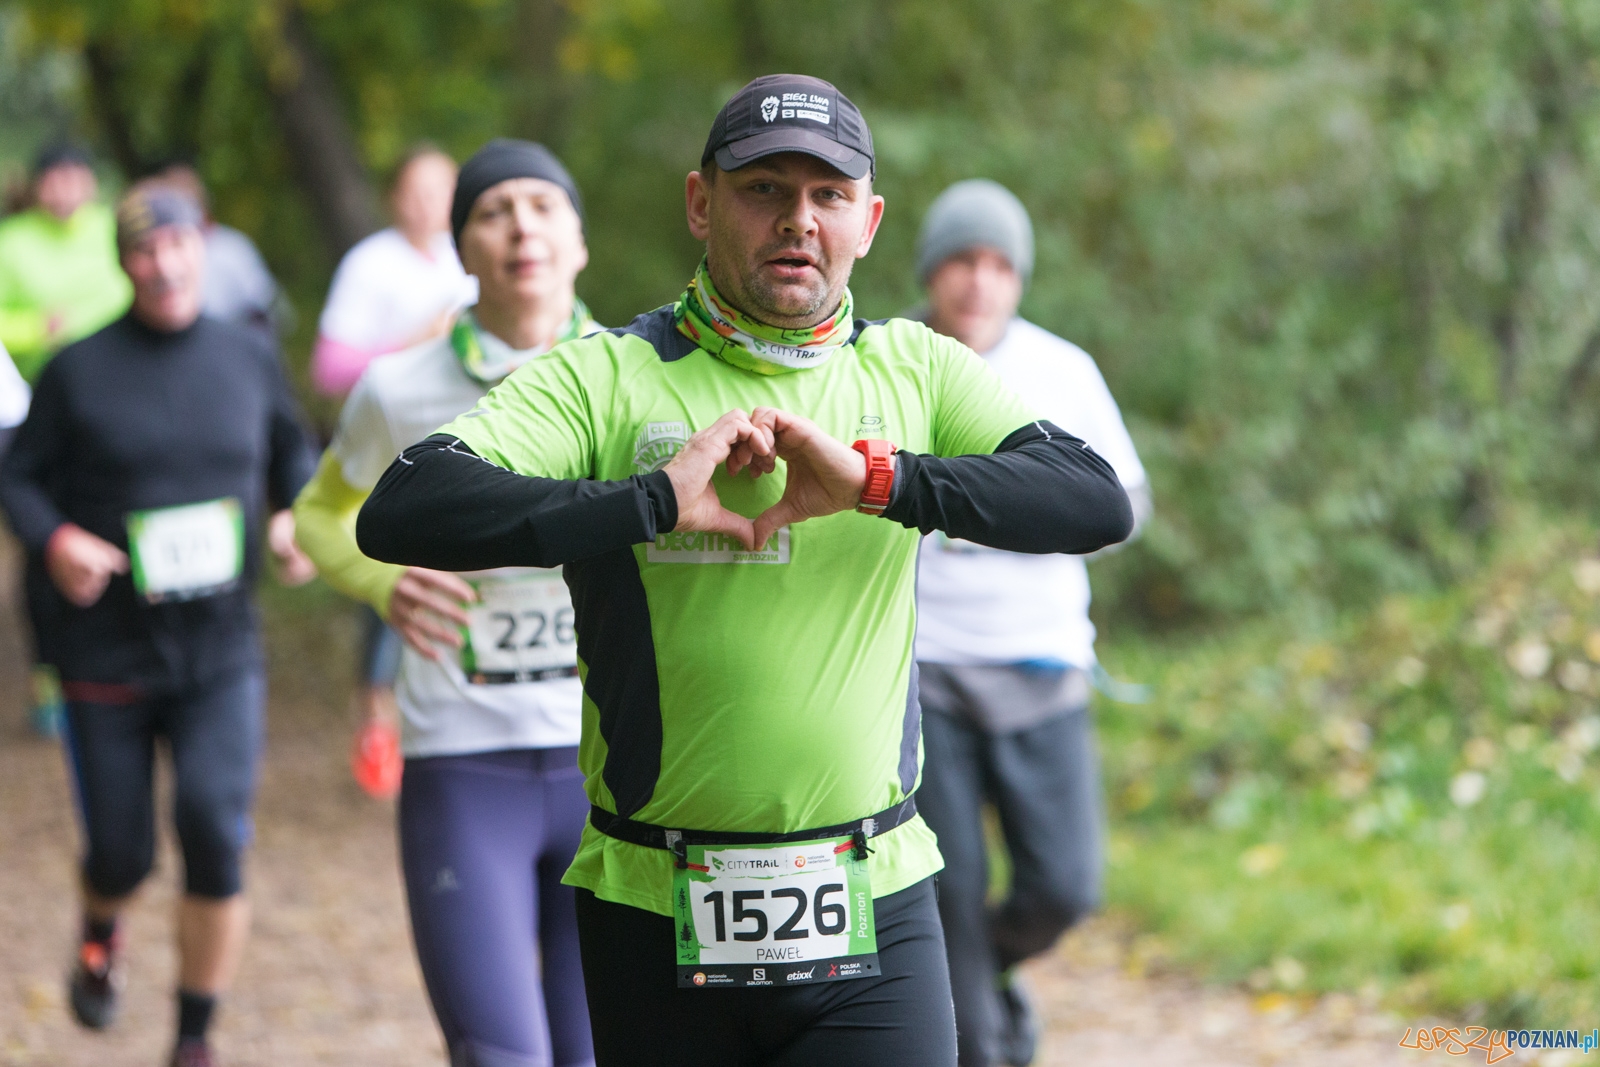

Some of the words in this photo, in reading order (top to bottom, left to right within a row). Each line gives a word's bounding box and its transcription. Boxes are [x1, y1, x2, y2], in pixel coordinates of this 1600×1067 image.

[782, 93, 807, 102] BIEG
[810, 95, 829, 106] LWA
[651, 425, 681, 434] CLUB
[733, 553, 779, 562] SWADZIM
[491, 607, 576, 651] 226
[704, 883, 846, 942] 1526
[858, 892, 868, 938] Poznań
[756, 947, 804, 960] PAWEŁ
